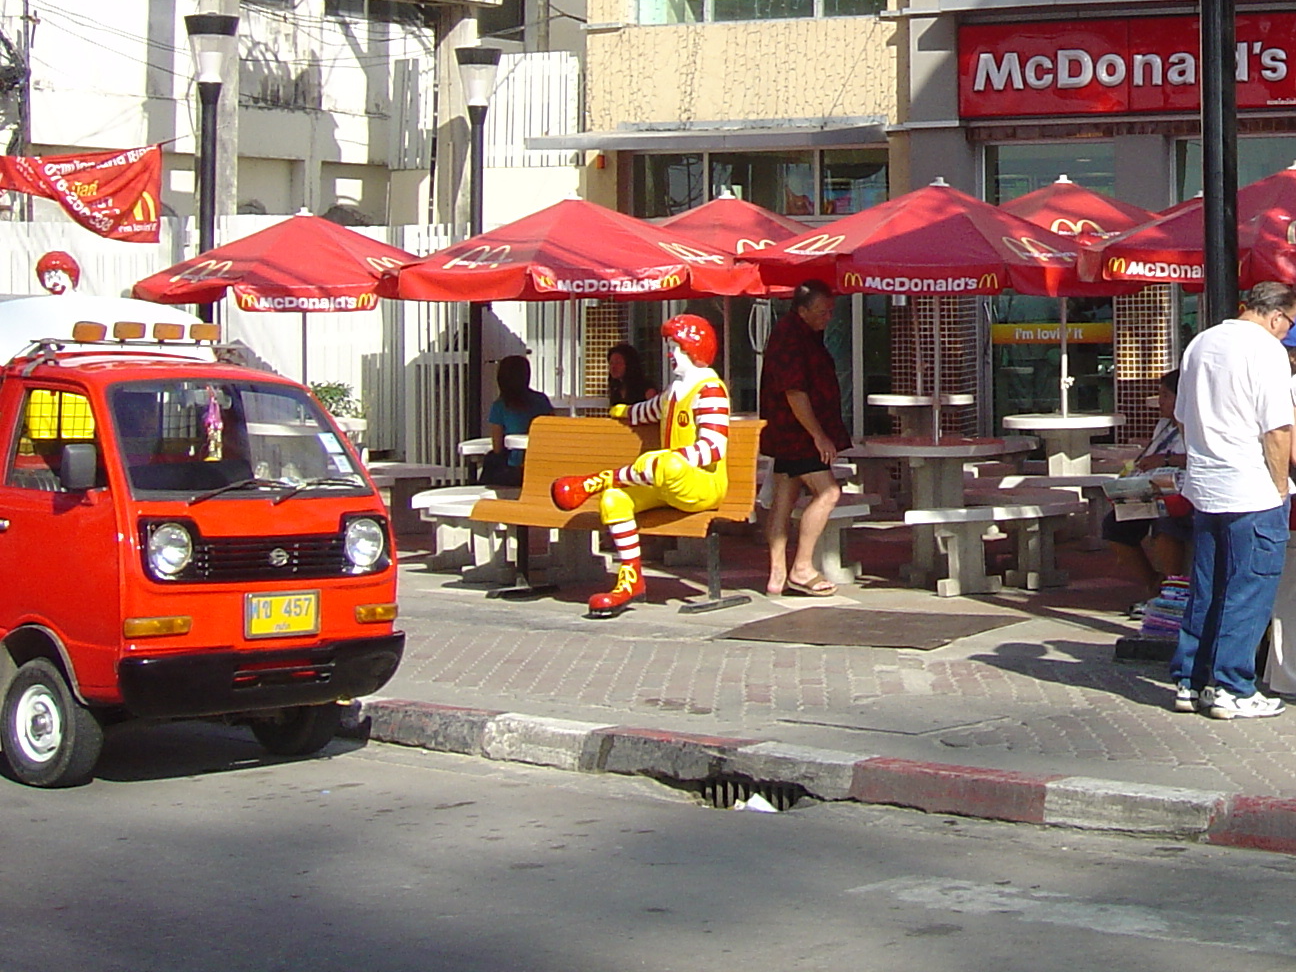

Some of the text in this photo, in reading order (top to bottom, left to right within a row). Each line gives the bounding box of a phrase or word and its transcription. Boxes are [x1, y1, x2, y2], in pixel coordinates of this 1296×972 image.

[557, 277, 662, 292] McDonald's
[864, 276, 978, 292] McDonald's
[258, 295, 358, 310] McDonald's
[1015, 328, 1083, 340] i'm lovi' it
[283, 598, 312, 617] 457
